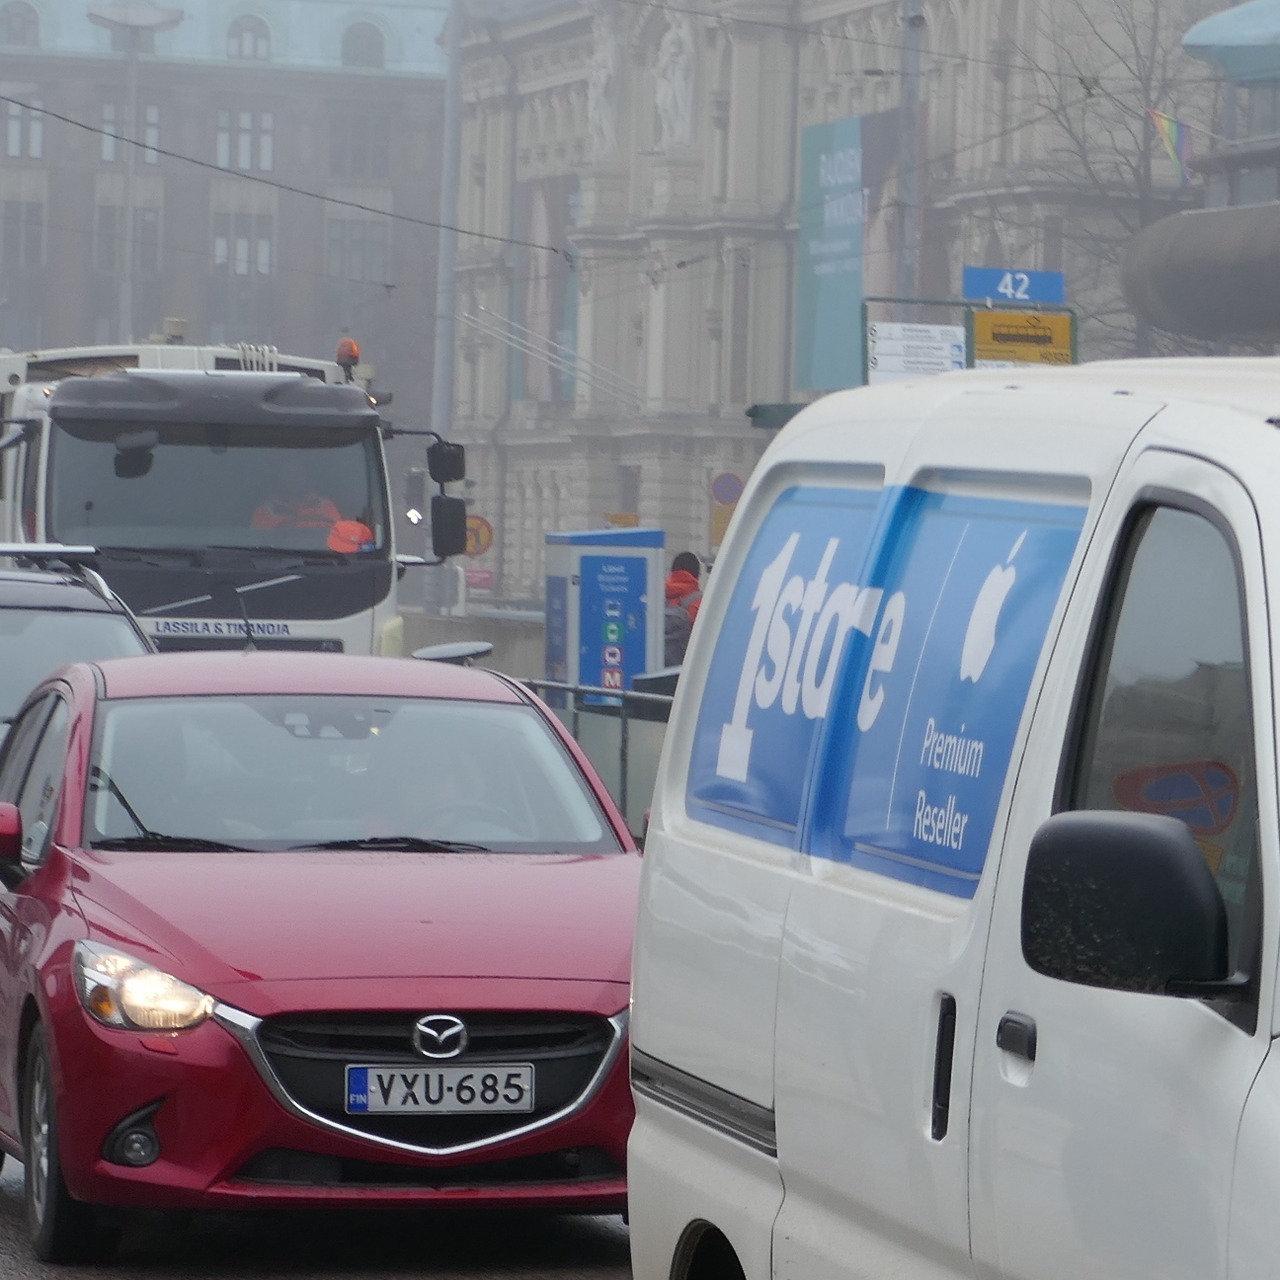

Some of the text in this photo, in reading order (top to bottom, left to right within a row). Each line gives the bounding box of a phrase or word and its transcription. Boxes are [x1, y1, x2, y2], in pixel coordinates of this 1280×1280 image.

[997, 272, 1030, 300] 42
[155, 620, 211, 635] LASSILA
[214, 621, 224, 635] &
[716, 531, 907, 783] 1store
[919, 717, 985, 778] Premium
[913, 790, 969, 850] Reseller
[349, 1072, 525, 1106] FIN VXU-685
